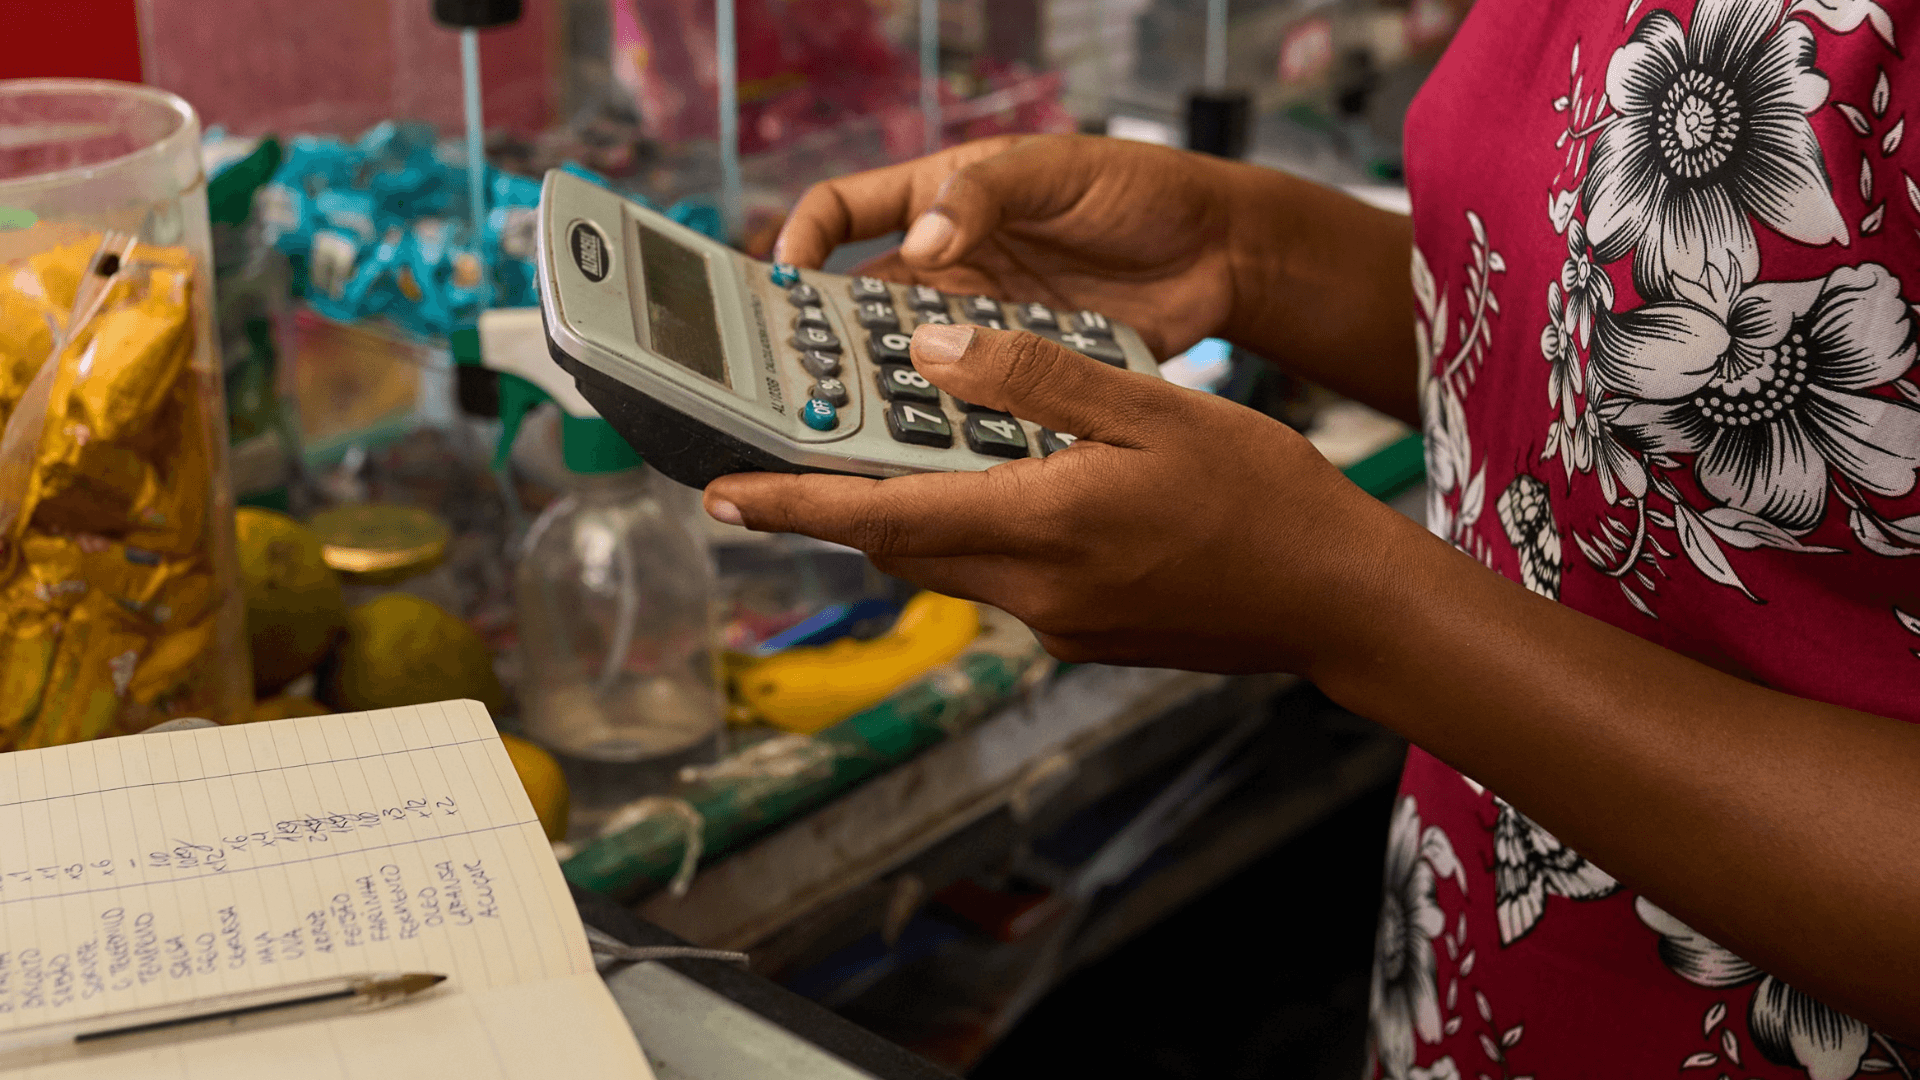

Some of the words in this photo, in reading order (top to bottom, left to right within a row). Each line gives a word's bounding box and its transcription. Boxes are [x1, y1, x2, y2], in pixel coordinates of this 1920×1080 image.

[882, 333, 913, 351] 9
[892, 368, 931, 389] 8
[812, 398, 832, 416] OFF
[903, 404, 942, 425] 7
[979, 418, 1017, 440] 4
